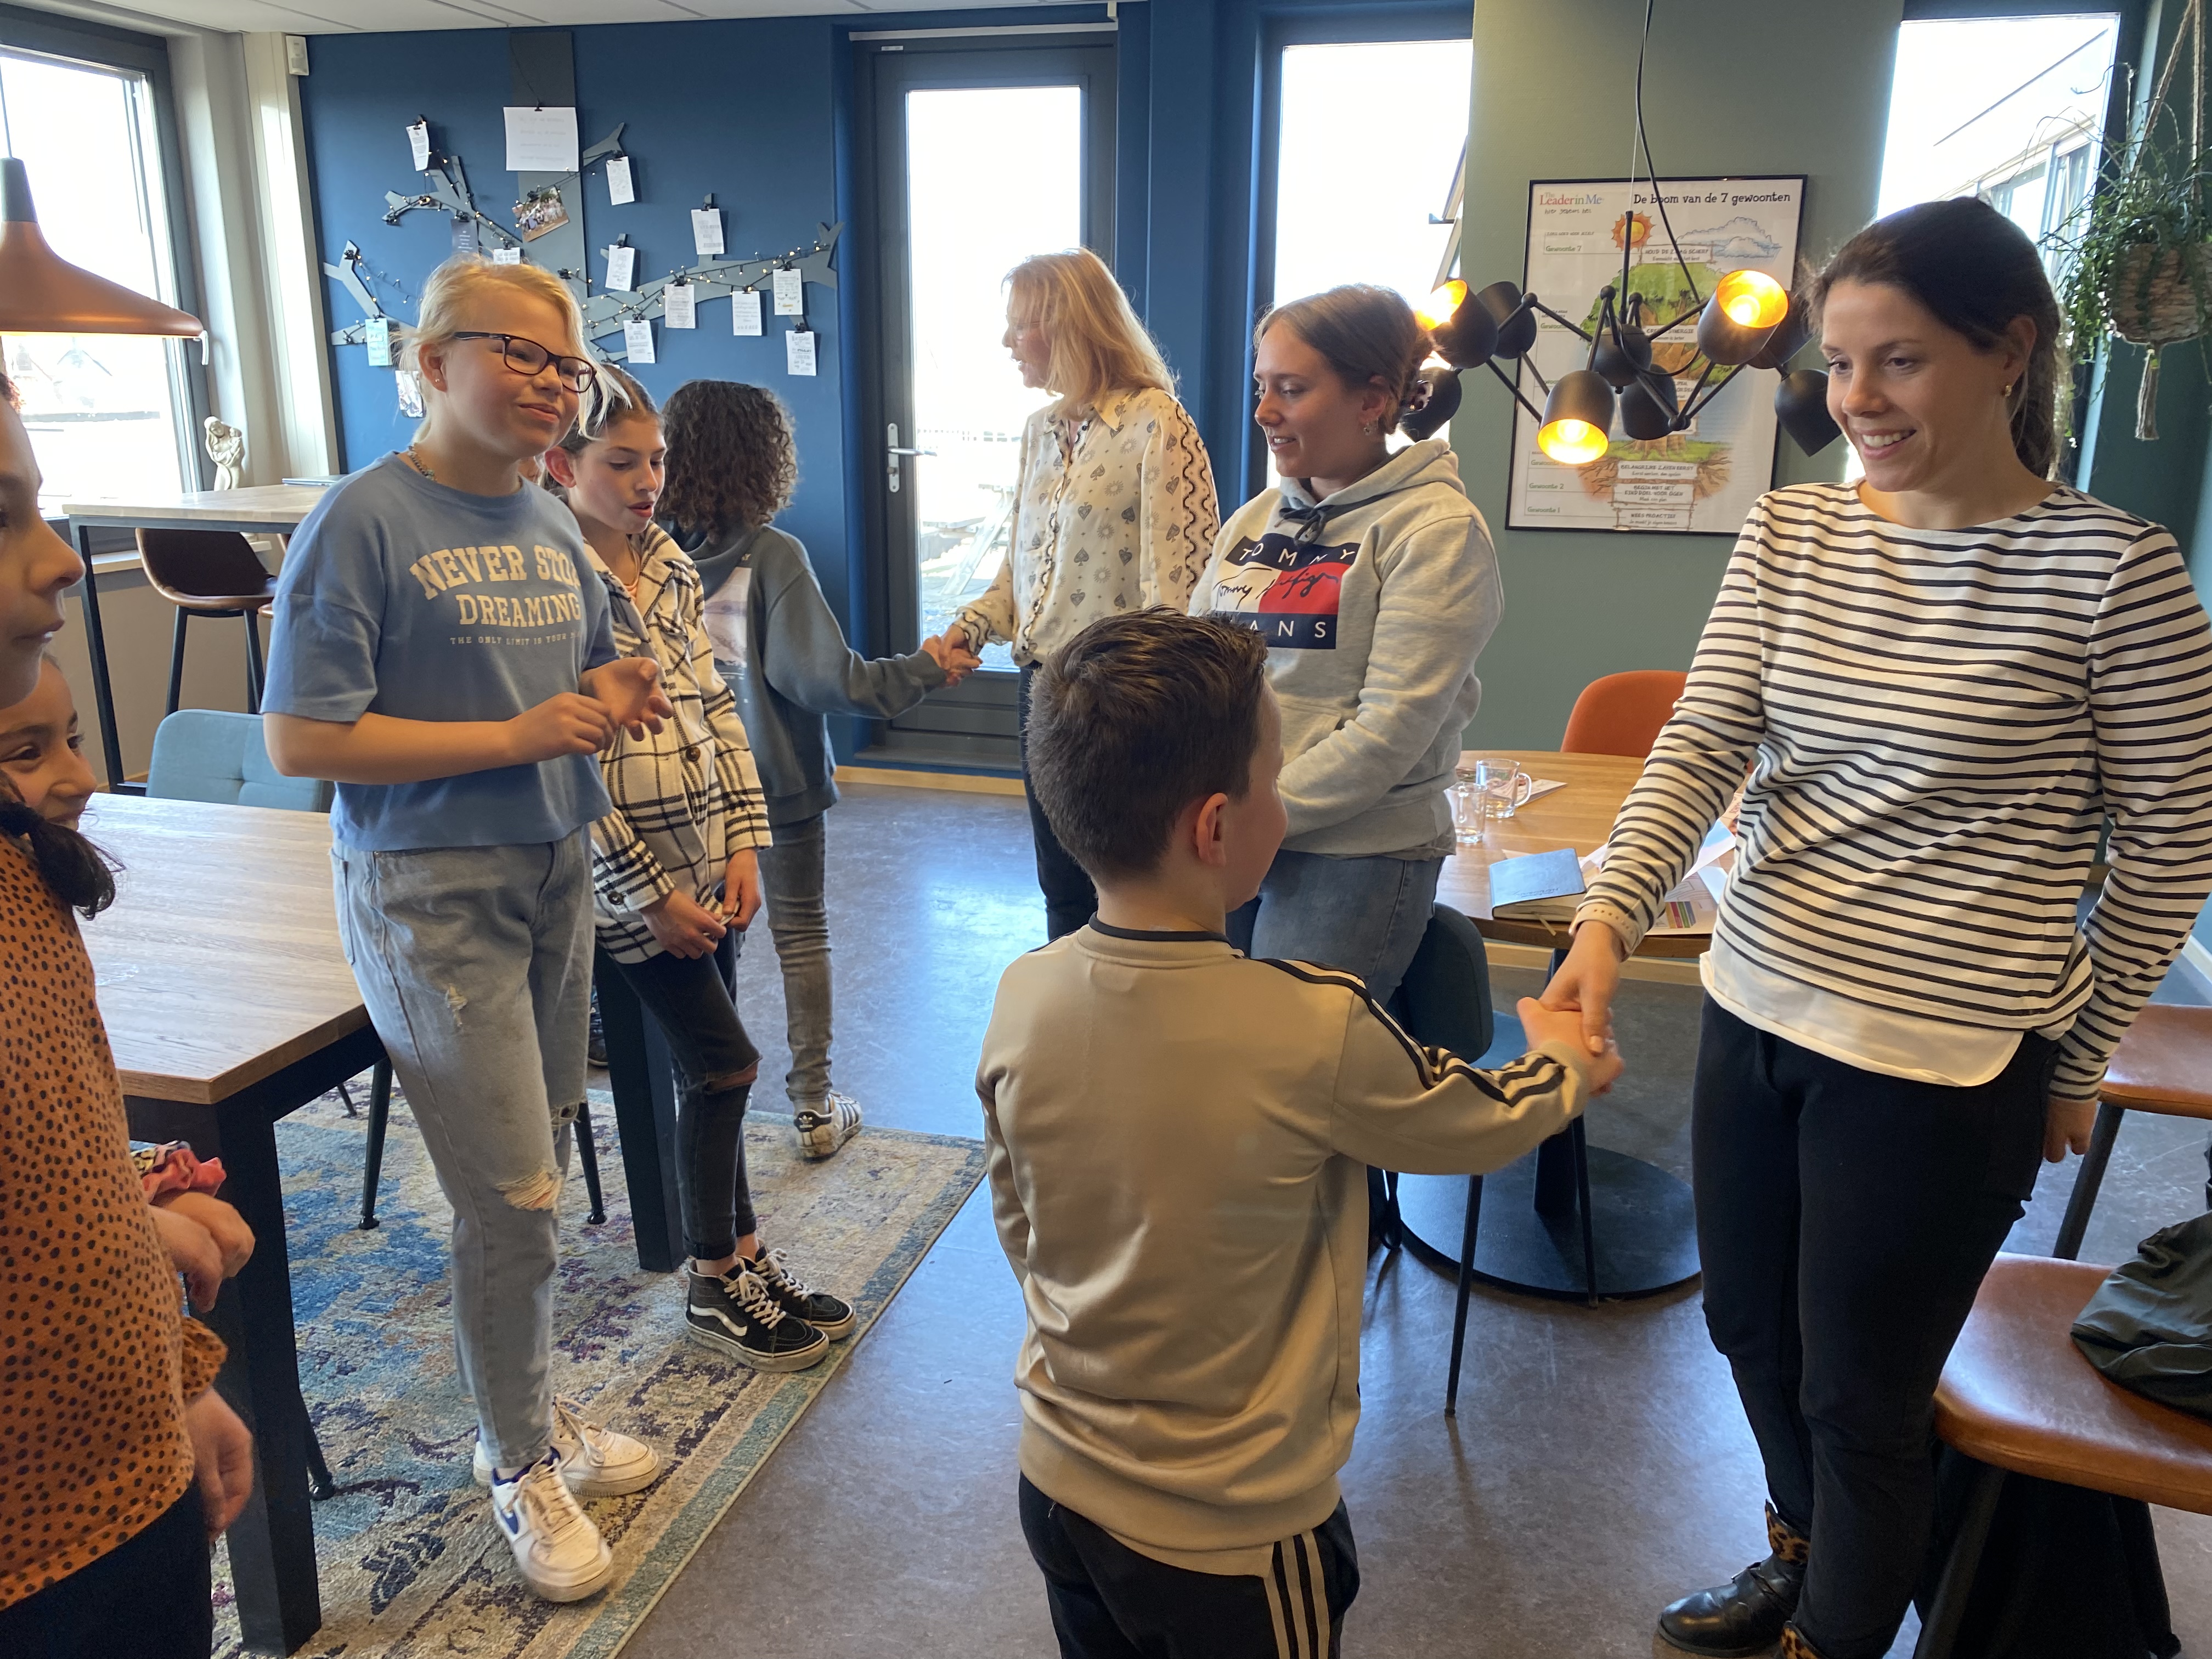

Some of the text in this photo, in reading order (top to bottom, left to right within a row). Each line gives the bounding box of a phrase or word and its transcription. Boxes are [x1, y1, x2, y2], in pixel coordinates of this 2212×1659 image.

[1539, 194, 1574, 205] Leader
[1585, 194, 1602, 205] Me
[1634, 194, 1647, 204] De
[1705, 193, 1717, 202] de
[1720, 193, 1728, 202] 7
[1731, 191, 1791, 206] gewoonten
[409, 545, 527, 600] NEVER
[455, 592, 582, 628] DREAMING
[1250, 620, 1327, 639] ANS
[450, 636, 472, 645] THE
[546, 633, 567, 643] YOUR
